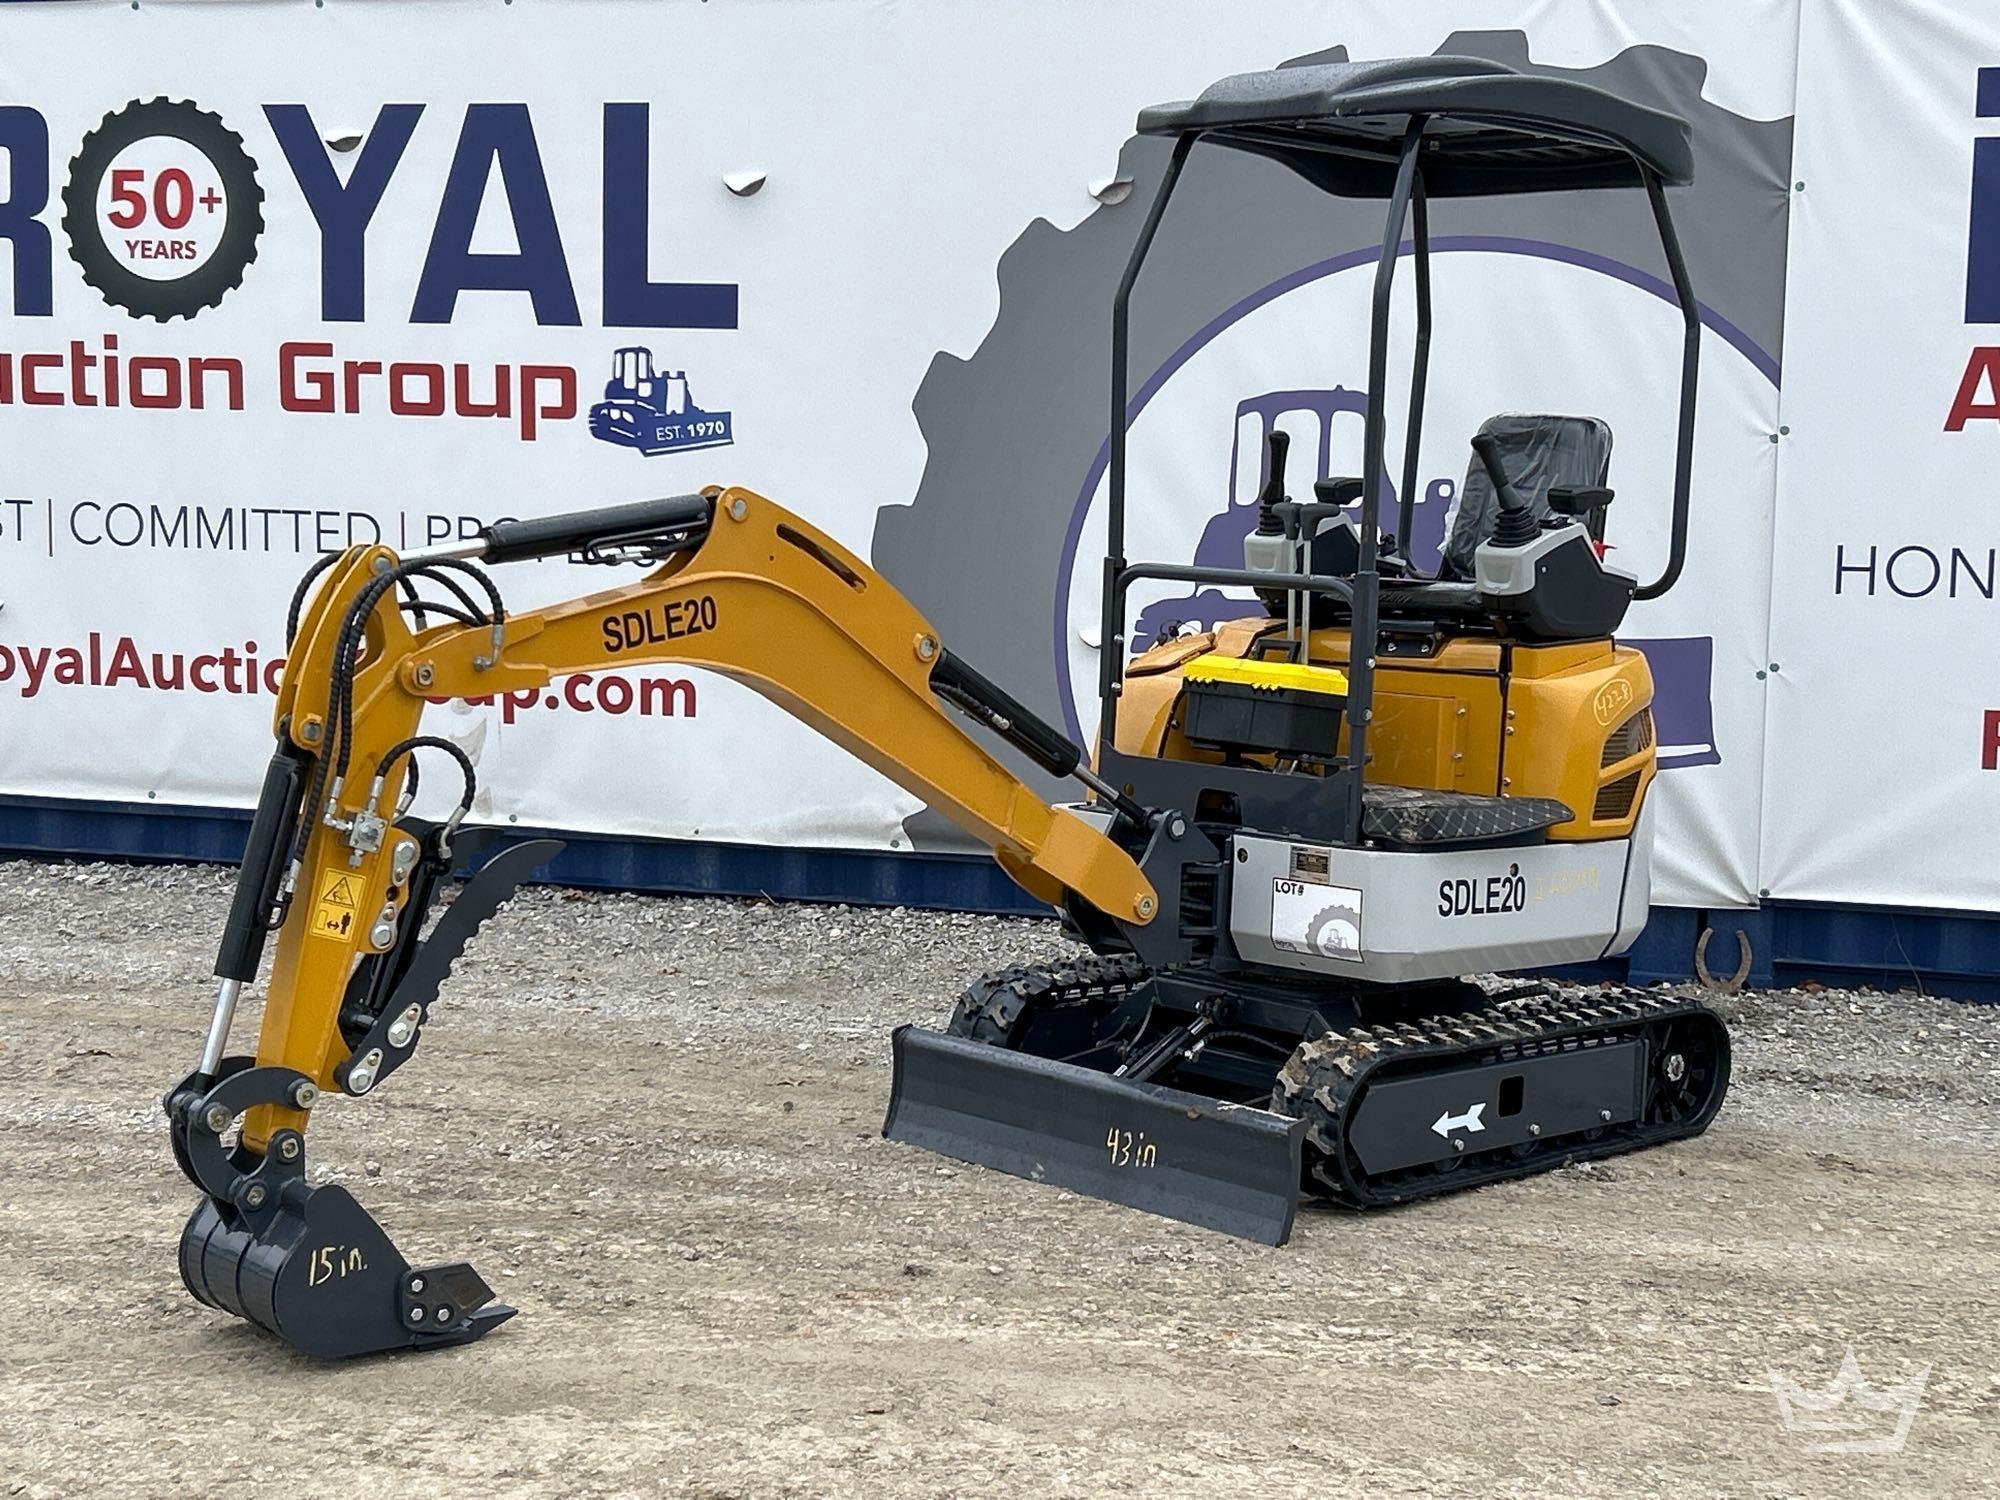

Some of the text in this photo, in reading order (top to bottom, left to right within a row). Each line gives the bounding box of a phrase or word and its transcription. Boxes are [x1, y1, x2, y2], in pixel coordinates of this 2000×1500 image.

[107, 168, 222, 229] 50+
[125, 240, 197, 259] YEARS
[0, 334, 578, 441] ction Group
[656, 421, 725, 441] EST. 1970
[70, 501, 382, 553] COMMITTED
[602, 595, 717, 652] SDLE20
[1275, 881, 1304, 895] LOT#
[1438, 875, 1525, 917] SDLE20
